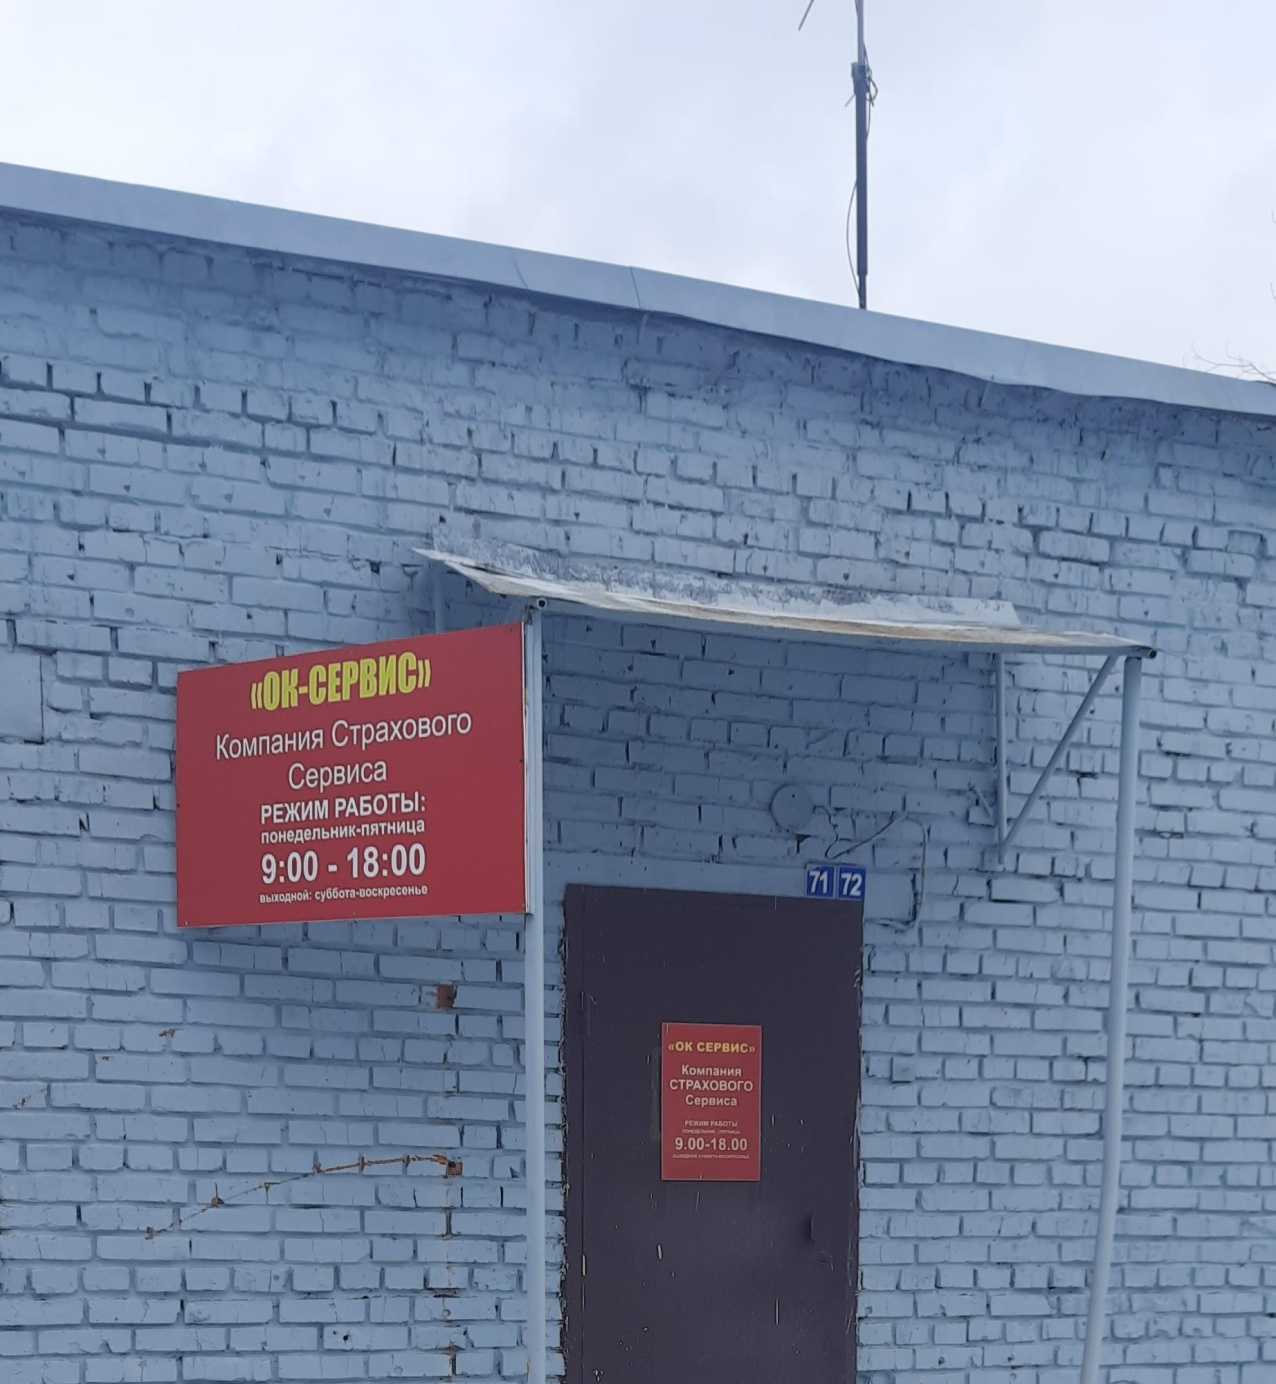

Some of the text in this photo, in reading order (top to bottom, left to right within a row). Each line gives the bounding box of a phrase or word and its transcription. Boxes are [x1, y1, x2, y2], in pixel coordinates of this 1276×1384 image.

[250, 651, 432, 712] «ОК-СЕРВИС»
[216, 711, 472, 760] Компания Страхового
[289, 761, 387, 792] Сервиса
[261, 793, 426, 824] РЕЖИМ РАБОТЫ:
[261, 819, 425, 845] понедельник-пятница
[261, 850, 318, 885] 9:00
[347, 843, 426, 878] 18:00
[259, 884, 428, 904] выходной: суббота-воскресенье
[809, 870, 829, 894] 71
[841, 872, 863, 896] 72
[682, 1064, 742, 1077] Компания
[670, 1079, 754, 1092] СТРАХОВОГО
[685, 1094, 737, 1107] Сервиса
[674, 1137, 748, 1151] 9.00-18.00
